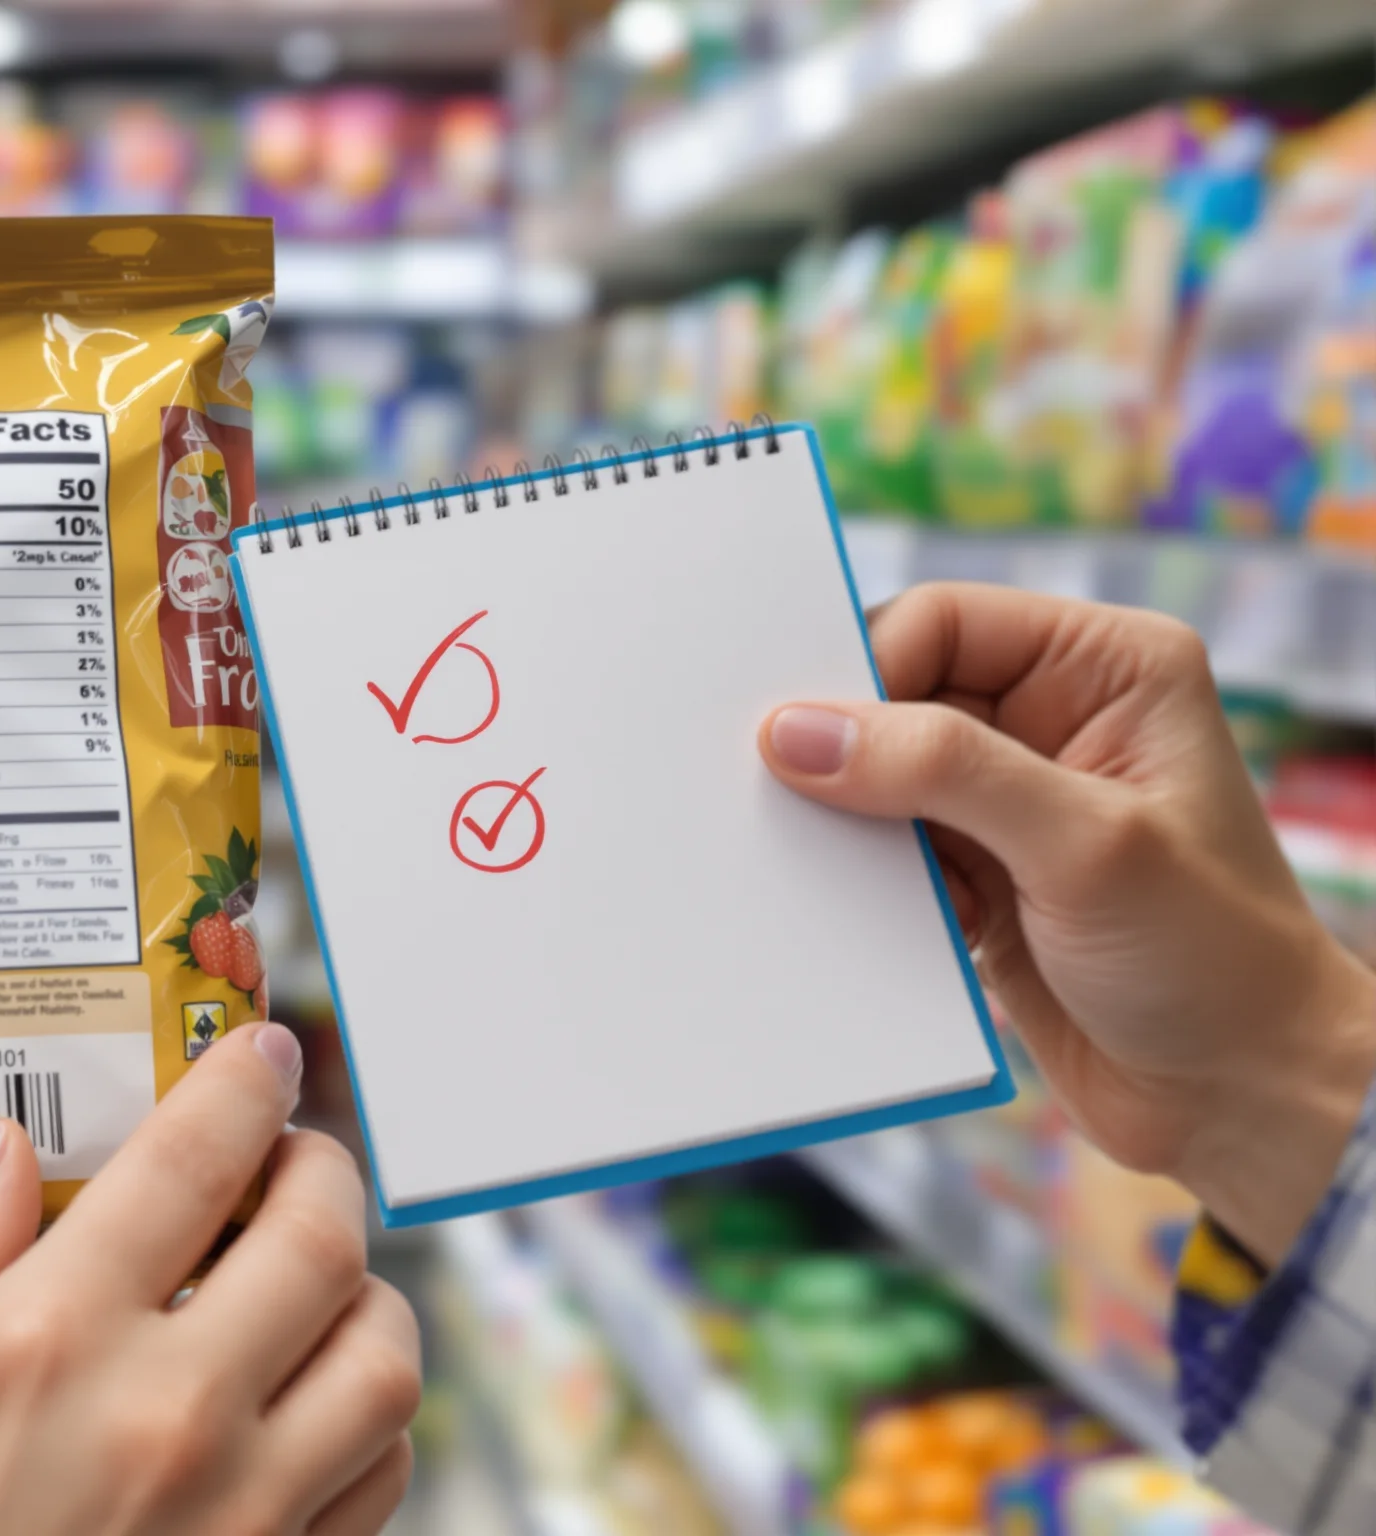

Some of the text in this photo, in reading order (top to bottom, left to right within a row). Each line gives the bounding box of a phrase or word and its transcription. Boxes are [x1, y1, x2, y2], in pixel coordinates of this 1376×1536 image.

[58, 478, 96, 501] 50
[55, 515, 103, 537] 10%
[75, 577, 102, 592] 0%
[76, 603, 103, 618] 3%
[80, 684, 106, 699] 6%
[81, 712, 108, 727] 1%
[85, 738, 111, 753] 9%
